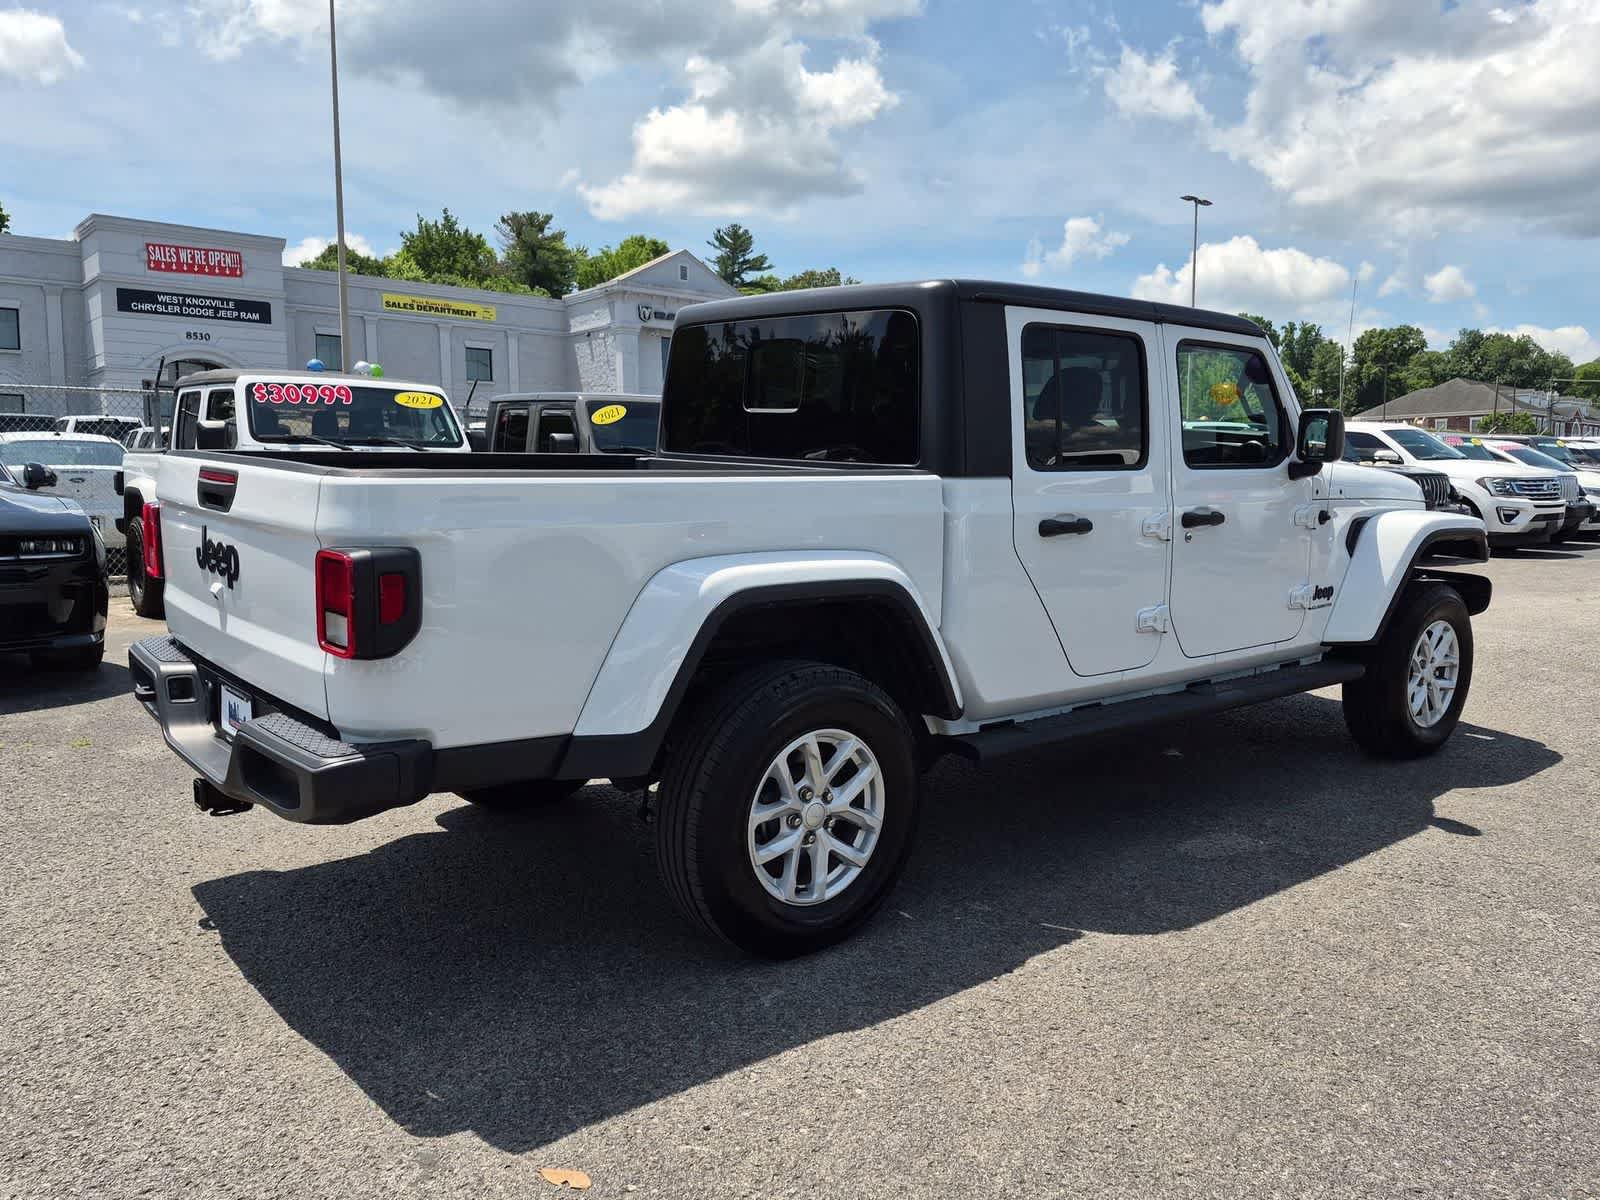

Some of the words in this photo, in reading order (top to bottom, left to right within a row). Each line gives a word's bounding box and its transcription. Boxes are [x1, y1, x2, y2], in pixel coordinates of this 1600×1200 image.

[148, 245, 177, 263] SALES
[178, 248, 207, 265] WE'RE
[208, 251, 240, 268] OPEN!!!
[157, 294, 184, 304] WEST
[185, 296, 235, 309] KNOXVILLE
[385, 300, 415, 311] SALES
[416, 303, 477, 317] DEPARTMENT
[131, 302, 181, 314] CHRYSLER
[182, 306, 215, 317] DODGE
[216, 309, 239, 319] JEEP
[240, 311, 260, 321] RAM
[185, 331, 211, 342] 8530
[253, 382, 352, 405] $30999
[404, 395, 433, 405] 2021
[598, 407, 620, 423] 2021
[196, 524, 240, 591] Jeep
[1312, 585, 1334, 601] Jeep
